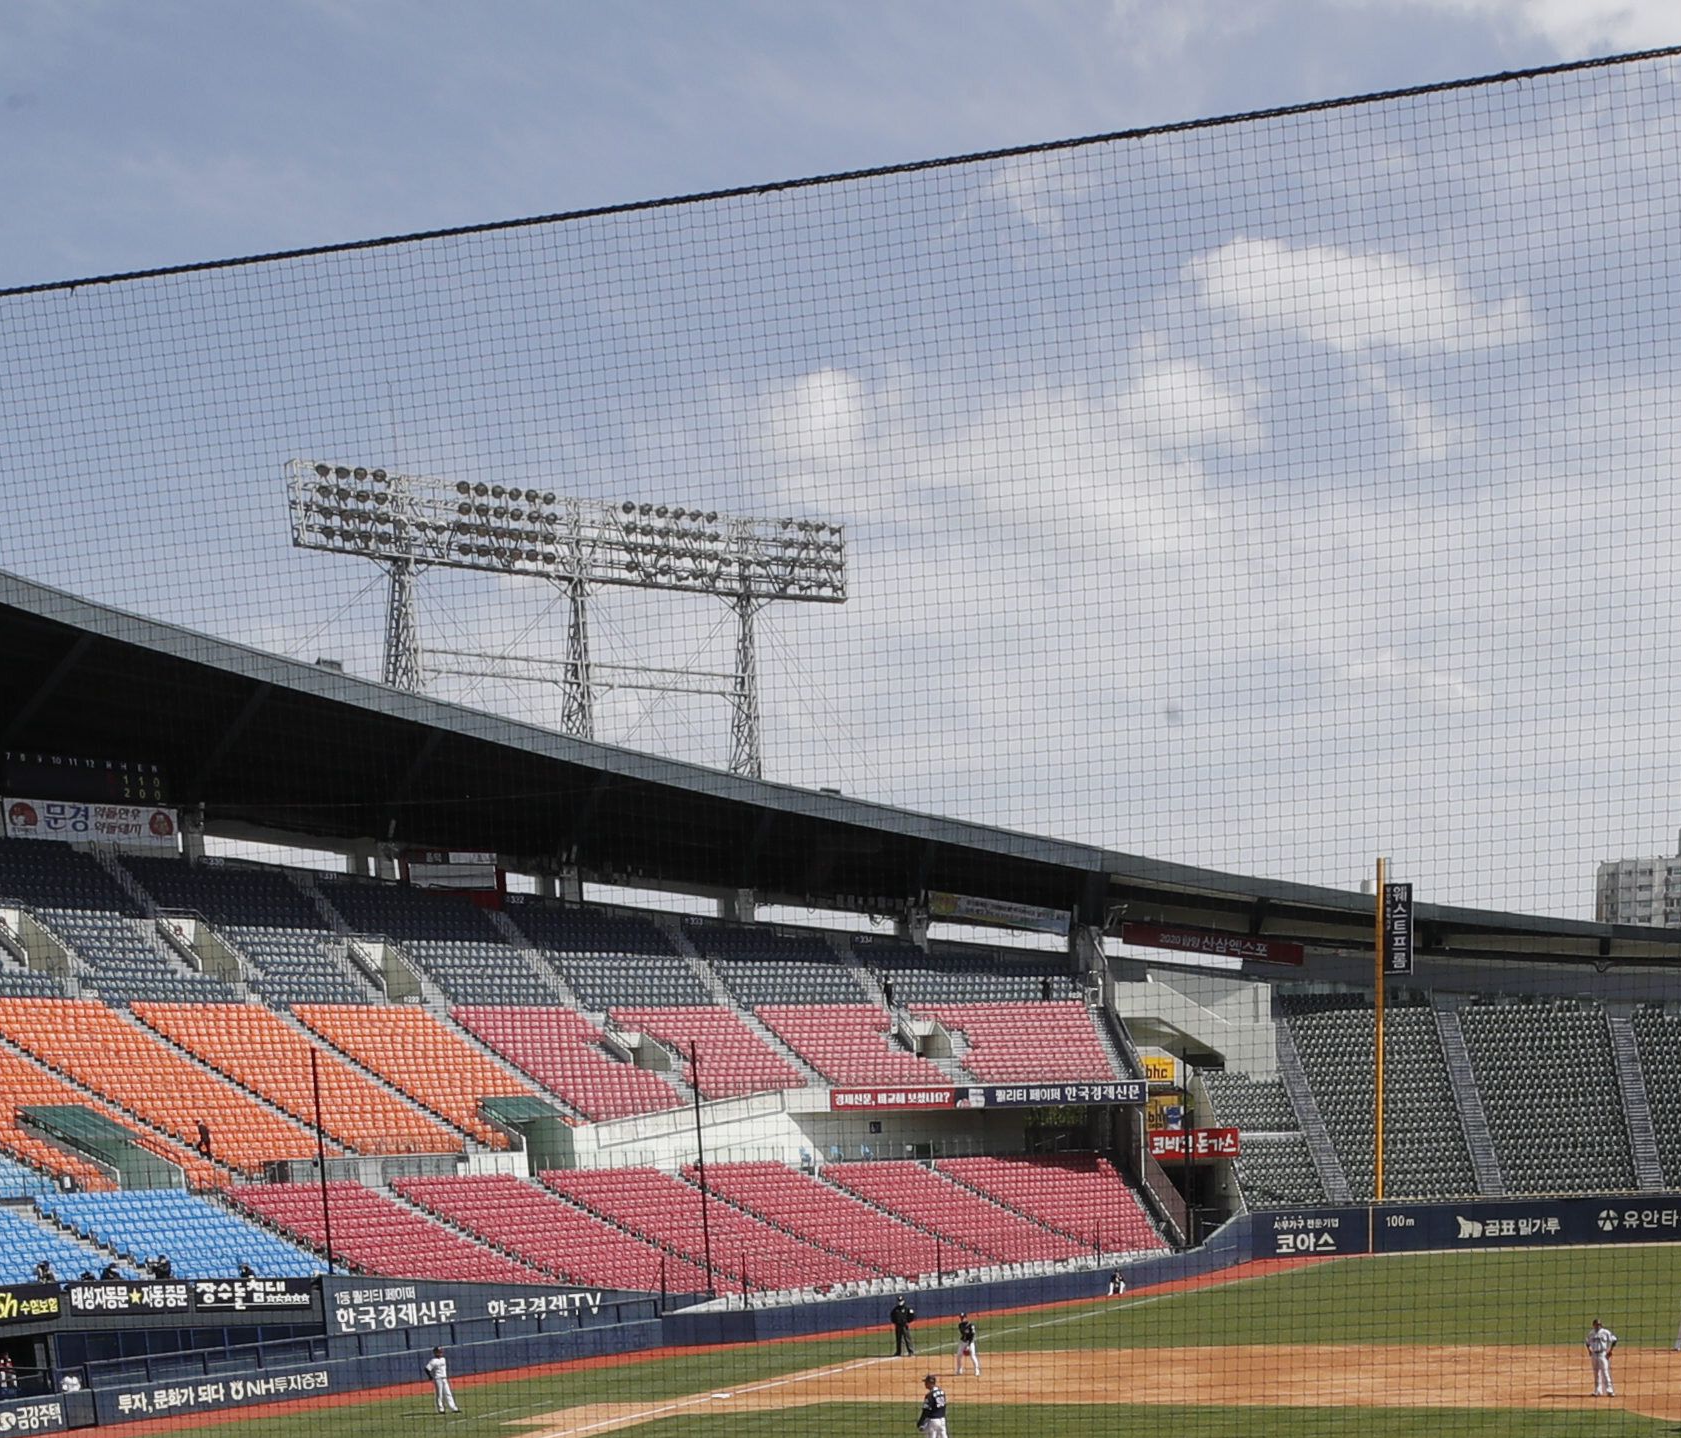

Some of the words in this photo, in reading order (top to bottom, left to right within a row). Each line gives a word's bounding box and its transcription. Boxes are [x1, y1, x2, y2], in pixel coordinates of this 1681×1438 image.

[45, 804, 89, 832] 문경
[1159, 933, 1181, 945] 2020
[1146, 1064, 1167, 1079] bhc
[1197, 1132, 1237, 1154] 돈가스
[1484, 1218, 1516, 1237] 곰표
[1518, 1216, 1561, 1237] 밀가루
[1276, 1232, 1336, 1253] 코아스
[19, 1297, 58, 1315] 수협보험
[141, 1284, 188, 1308] 자동중문
[196, 1280, 286, 1311] 장수돌침대
[334, 1291, 351, 1305] 1등
[384, 1286, 416, 1301] 페이퍼
[336, 1300, 457, 1332] 한국경제신문
[487, 1292, 602, 1323] 한국경제TV
[154, 1386, 195, 1408] 문화가
[197, 1383, 225, 1402] 되다
[246, 1371, 329, 1397] NH투자증권
[17, 1403, 62, 1429] 금강주택
